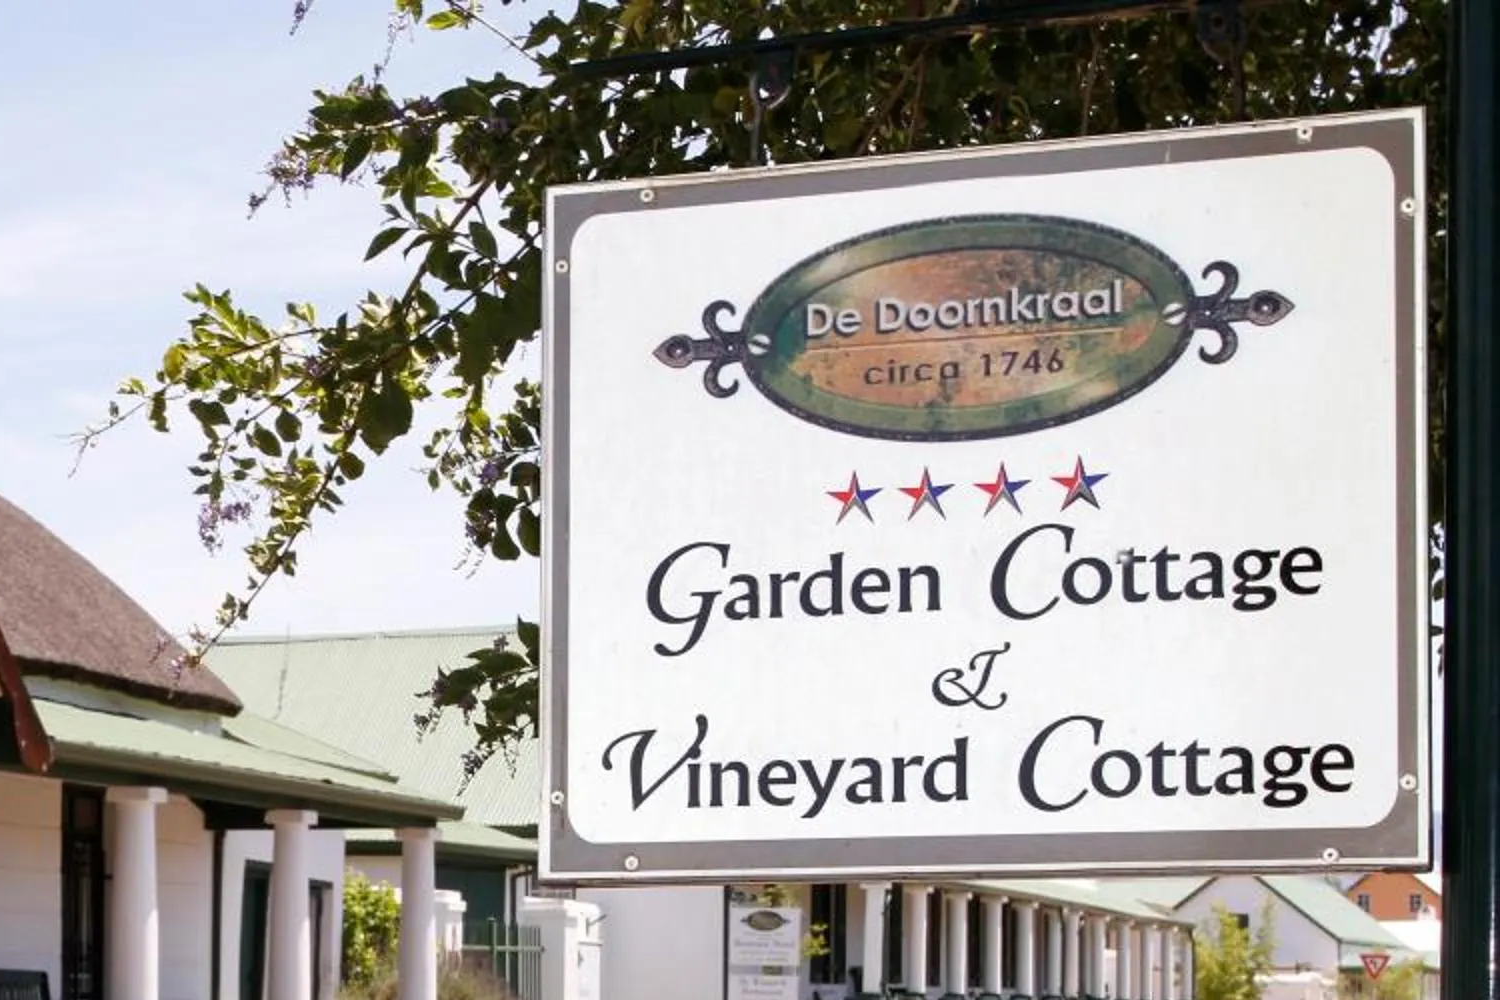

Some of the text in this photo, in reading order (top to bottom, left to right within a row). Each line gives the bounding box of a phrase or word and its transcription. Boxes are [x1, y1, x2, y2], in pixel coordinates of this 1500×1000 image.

[806, 279, 1124, 338] De Doornkraal
[864, 347, 1065, 386] circa 1746
[646, 523, 1323, 657] Garden Cottage
[931, 641, 1011, 711] &
[602, 714, 1355, 819] Vineyard Cottage
